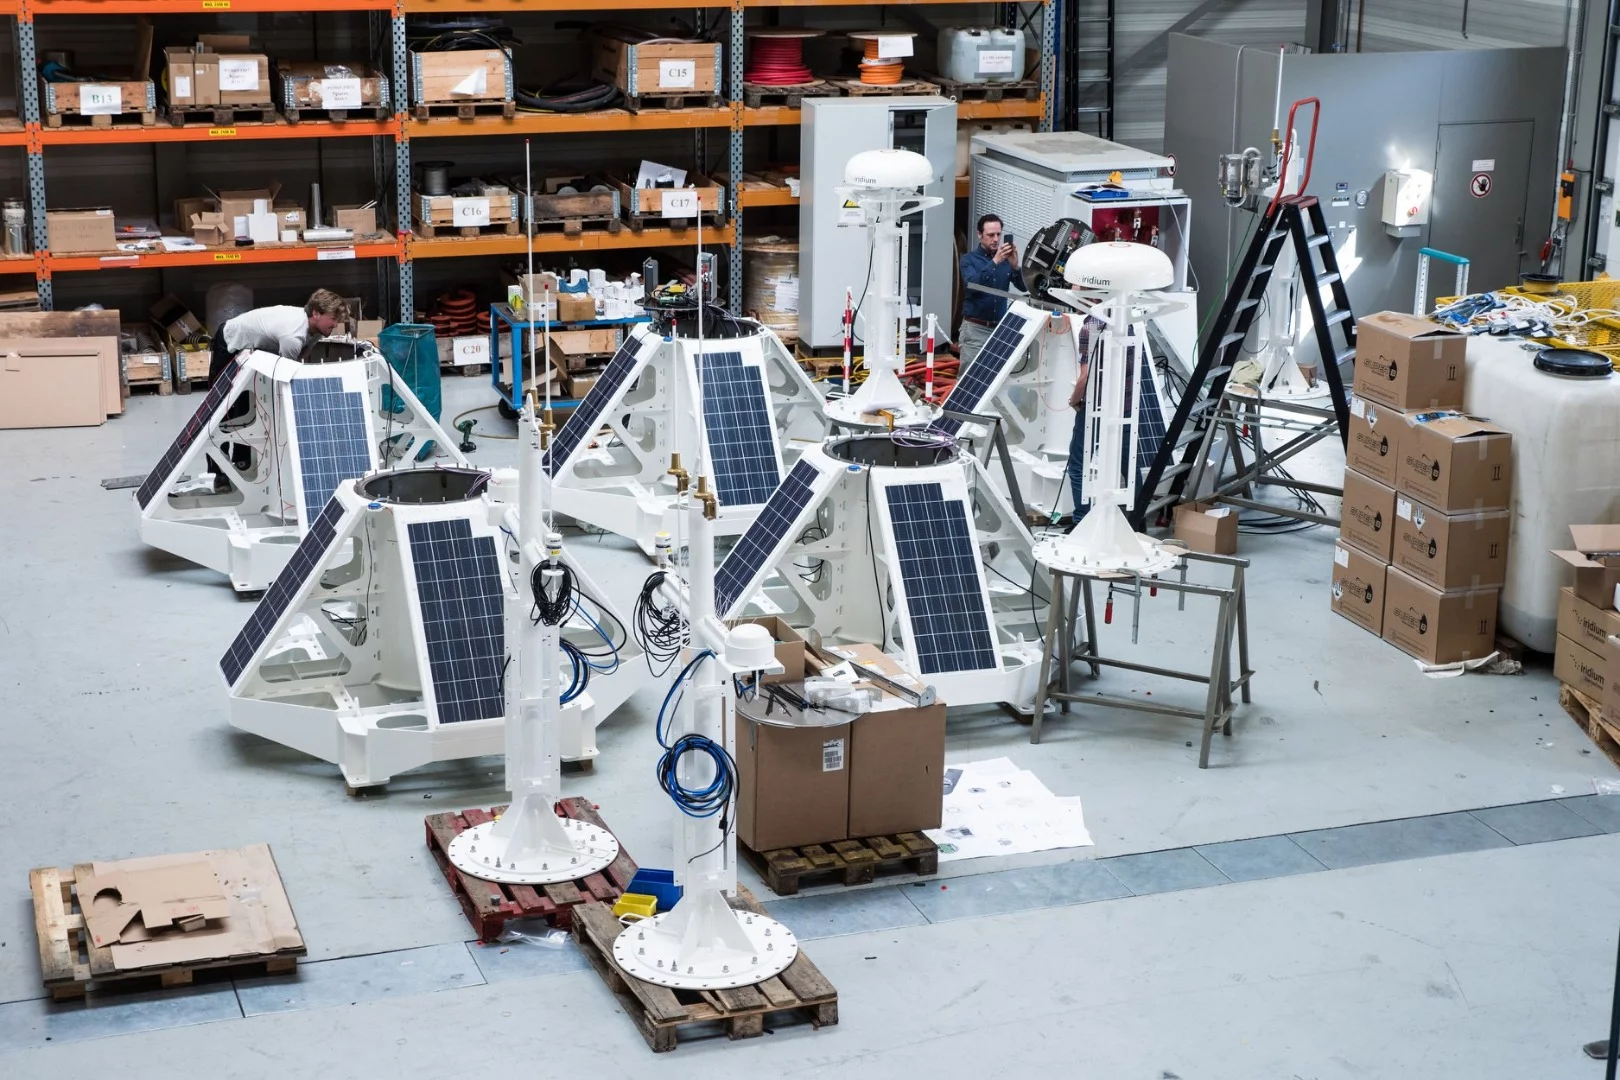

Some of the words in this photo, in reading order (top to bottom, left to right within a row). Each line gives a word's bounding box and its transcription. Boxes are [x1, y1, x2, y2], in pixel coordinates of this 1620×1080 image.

[668, 68, 687, 78] C15
[92, 94, 112, 104] B13
[462, 208, 482, 216] C16
[671, 199, 690, 208] C17
[1082, 276, 1110, 286] iridium
[463, 346, 481, 354] C20
[1364, 358, 1388, 375] SUPER
[1357, 433, 1380, 450] SUPER
[1406, 456, 1431, 474] SUPER
[1350, 507, 1374, 525] SUPER
[1403, 533, 1428, 552] SUPER
[1394, 608, 1420, 627] SUPER
[1583, 617, 1606, 638] iridium
[1580, 663, 1604, 685] iridium
